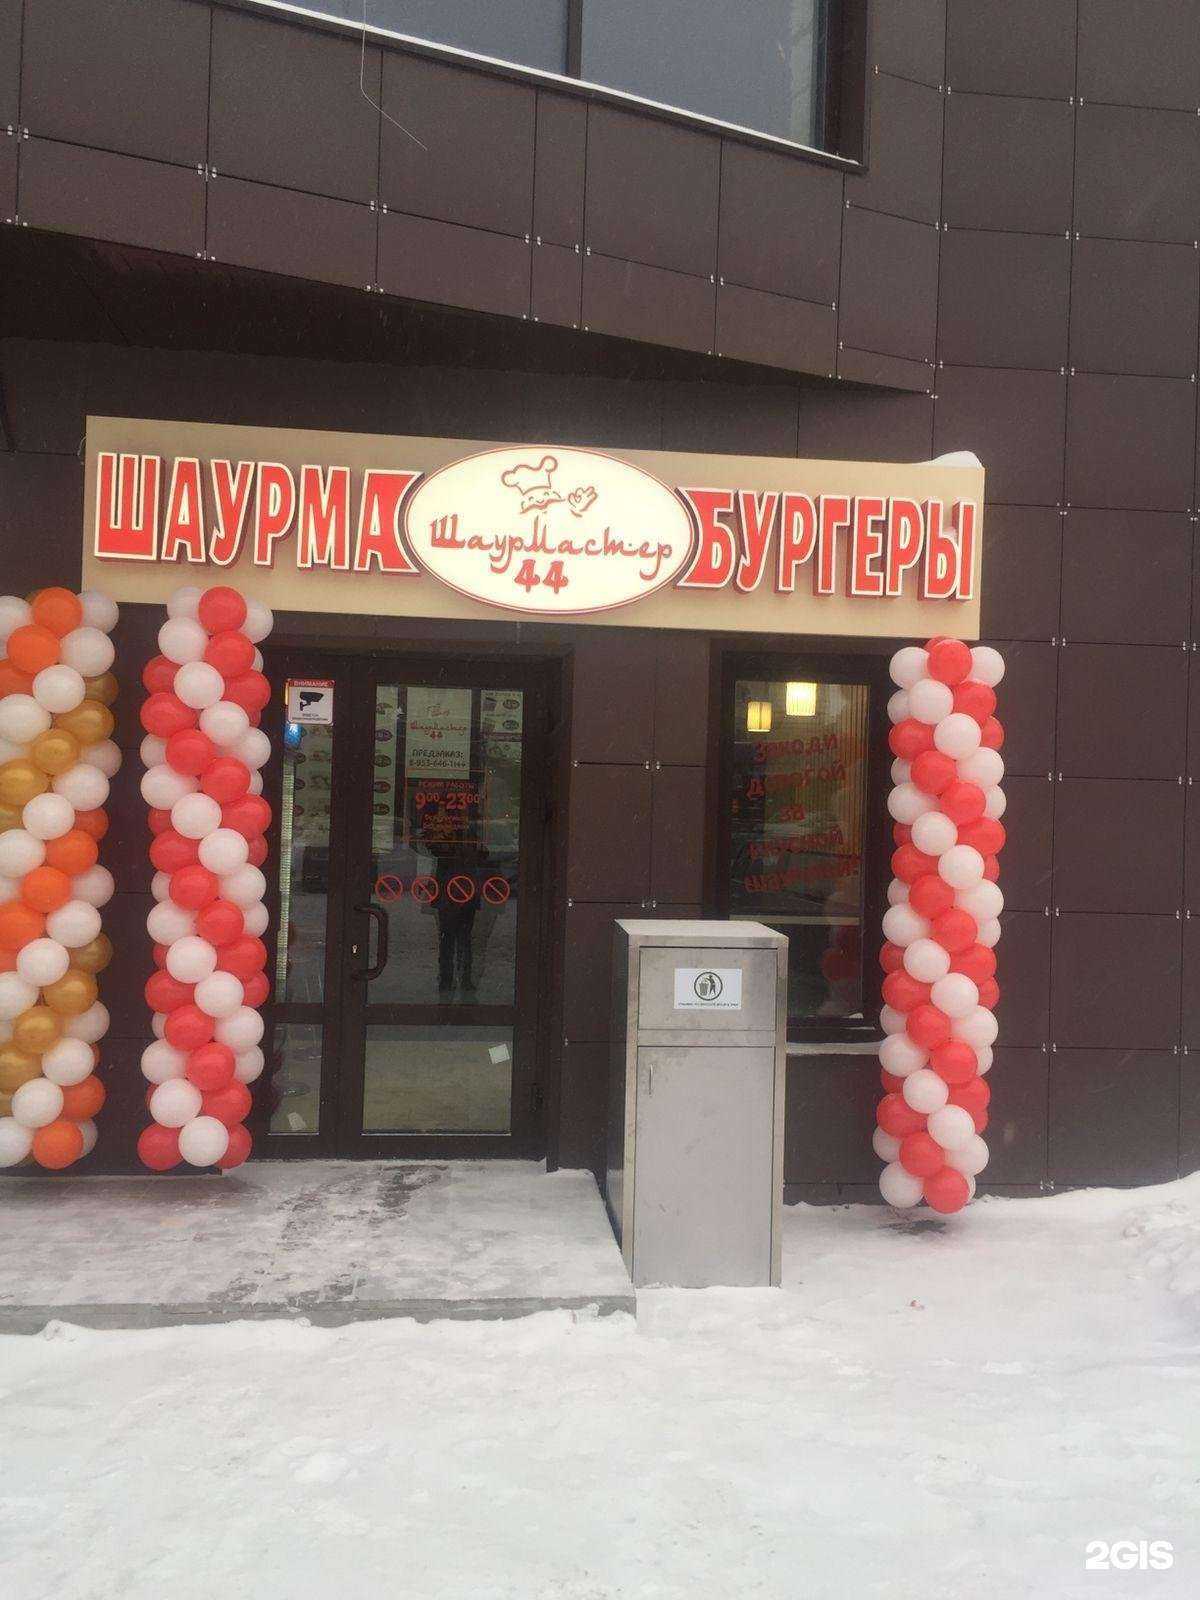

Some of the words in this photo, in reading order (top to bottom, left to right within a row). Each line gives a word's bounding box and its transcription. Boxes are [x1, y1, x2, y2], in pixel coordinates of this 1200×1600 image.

[93, 452, 425, 574] ШАУРМА
[430, 513, 674, 580] ШаурМастер
[677, 487, 977, 601] БУРГЕРЫ
[514, 558, 569, 594] 44
